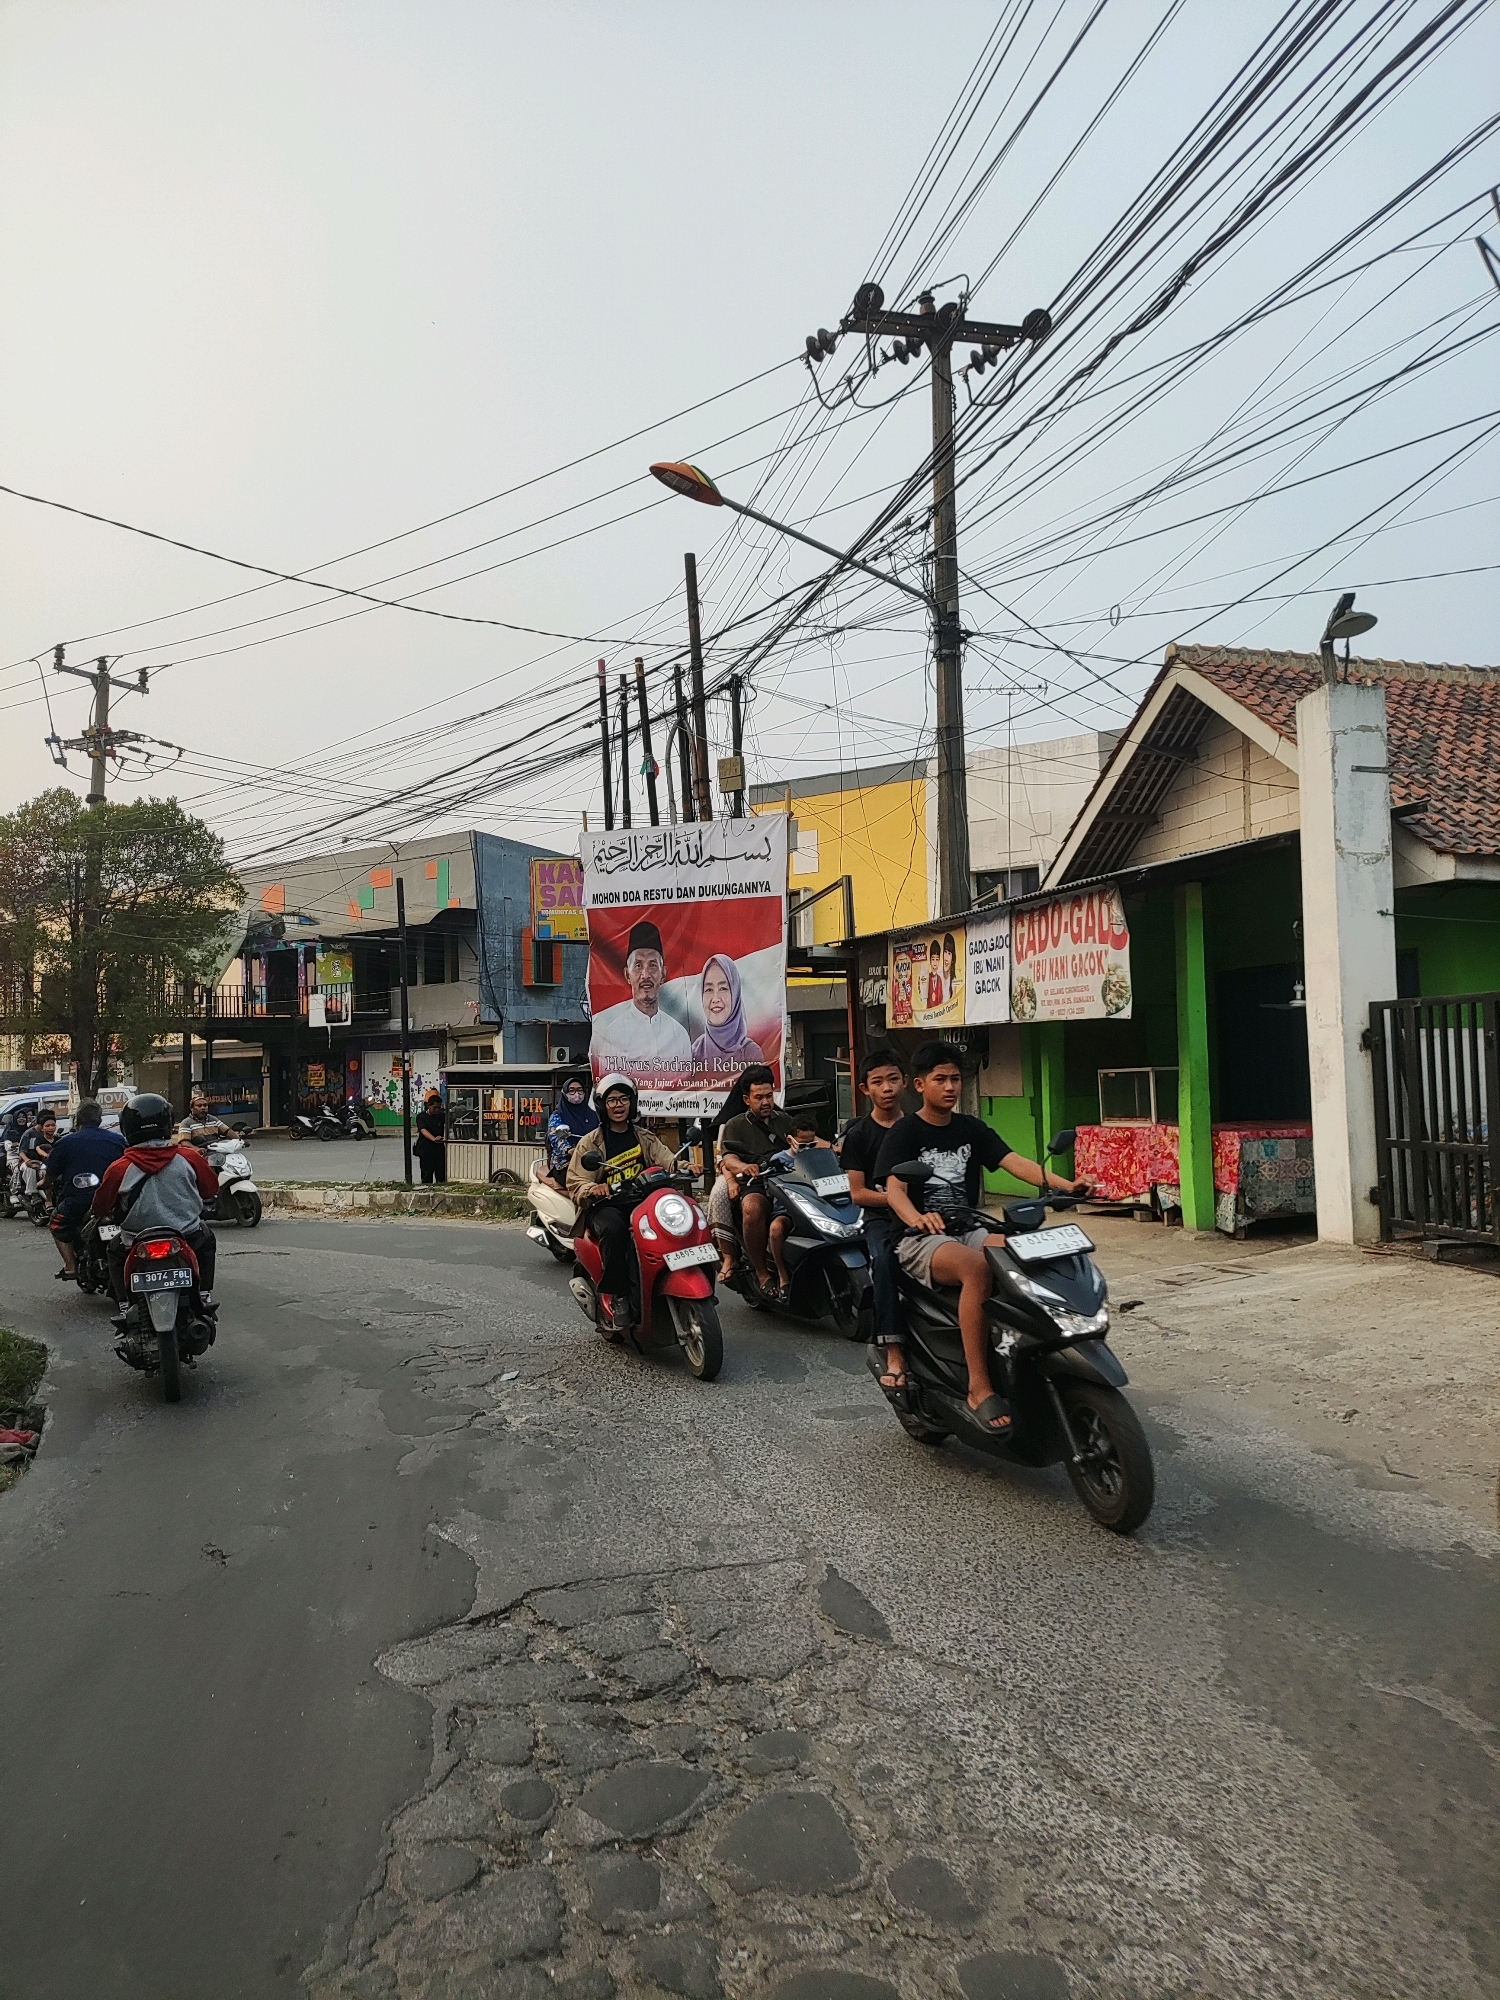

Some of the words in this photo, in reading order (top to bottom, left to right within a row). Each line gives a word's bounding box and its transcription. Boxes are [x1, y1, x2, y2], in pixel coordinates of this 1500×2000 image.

[592, 891, 620, 905] MOHON
[622, 889, 641, 903] DOA
[643, 887, 674, 901] RESTU
[676, 885, 696, 899] DAN
[698, 880, 772, 898] DUKUNGANNYA
[968, 938, 987, 956] GADO
[973, 960, 984, 976] IBU
[985, 956, 1005, 973] NANI
[1049, 954, 1069, 981] NANI
[975, 976, 1001, 995] GACOK
[652, 1055, 709, 1077] Sudrajat
[634, 1078, 653, 1089] Yang
[654, 1078, 676, 1089] Jujur,
[677, 1077, 709, 1088] Amanah
[711, 1078, 727, 1088] Dan
[665, 1097, 700, 1112] Sejahtera
[1011, 1238, 1022, 1248] B
[1027, 1231, 1056, 1246] 6145
[666, 1254, 671, 1263] F
[133, 1275, 139, 1283] B
[145, 1272, 168, 1282] 3074
